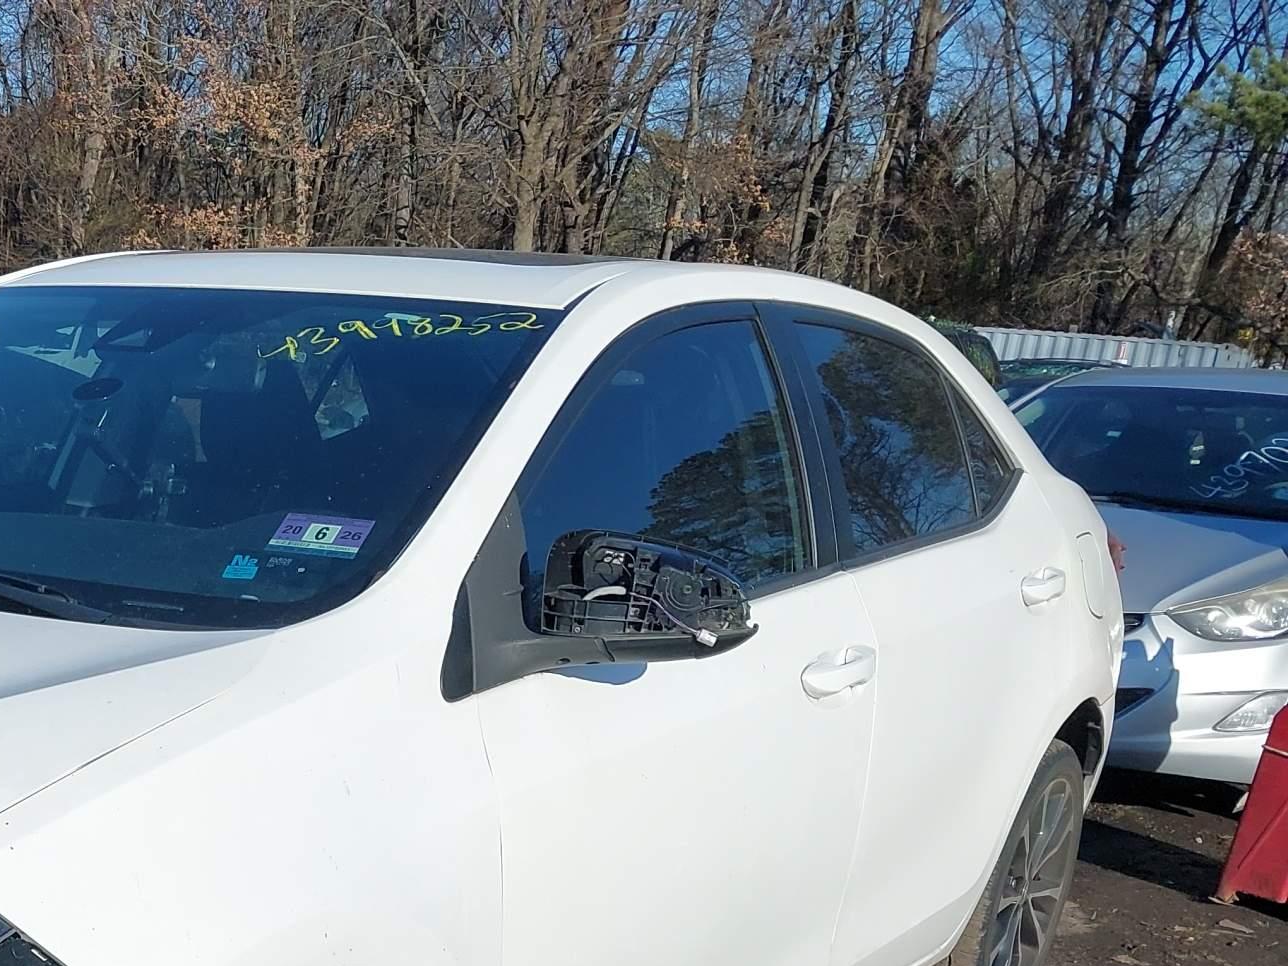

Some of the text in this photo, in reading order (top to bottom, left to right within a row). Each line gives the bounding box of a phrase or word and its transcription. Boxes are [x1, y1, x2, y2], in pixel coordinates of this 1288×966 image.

[257, 312, 544, 361] 43998252
[281, 524, 362, 541] 20 6 26
